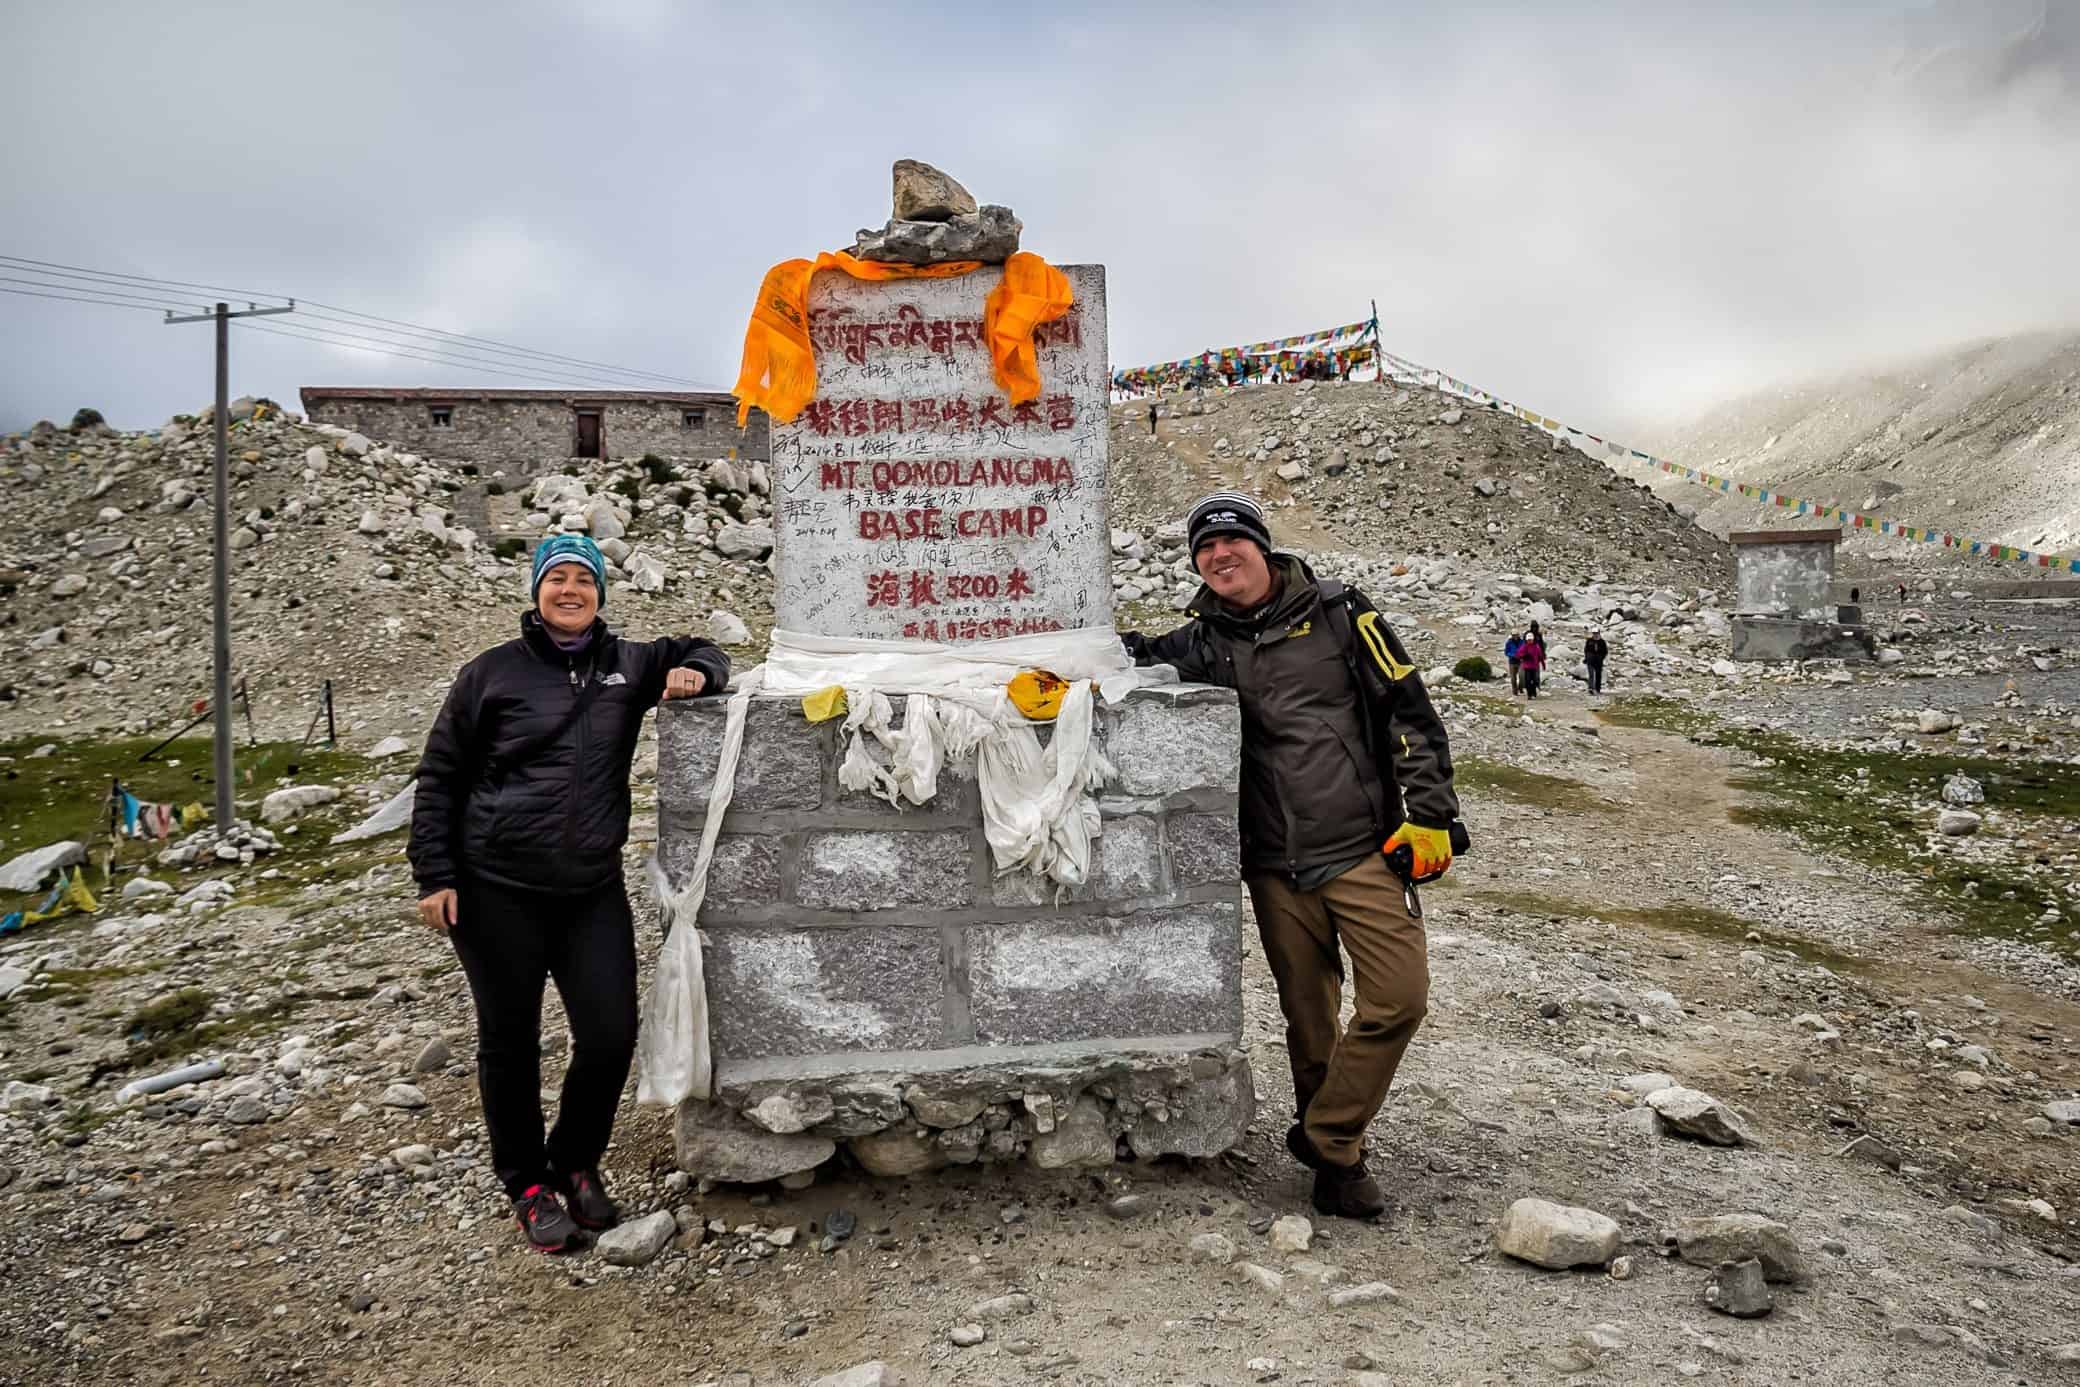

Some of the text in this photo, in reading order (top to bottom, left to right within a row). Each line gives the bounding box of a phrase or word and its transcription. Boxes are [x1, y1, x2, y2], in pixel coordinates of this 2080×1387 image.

[872, 457, 1074, 492] QOMOLANGMA
[859, 507, 942, 541] BASE
[957, 505, 1048, 538] CAMP
